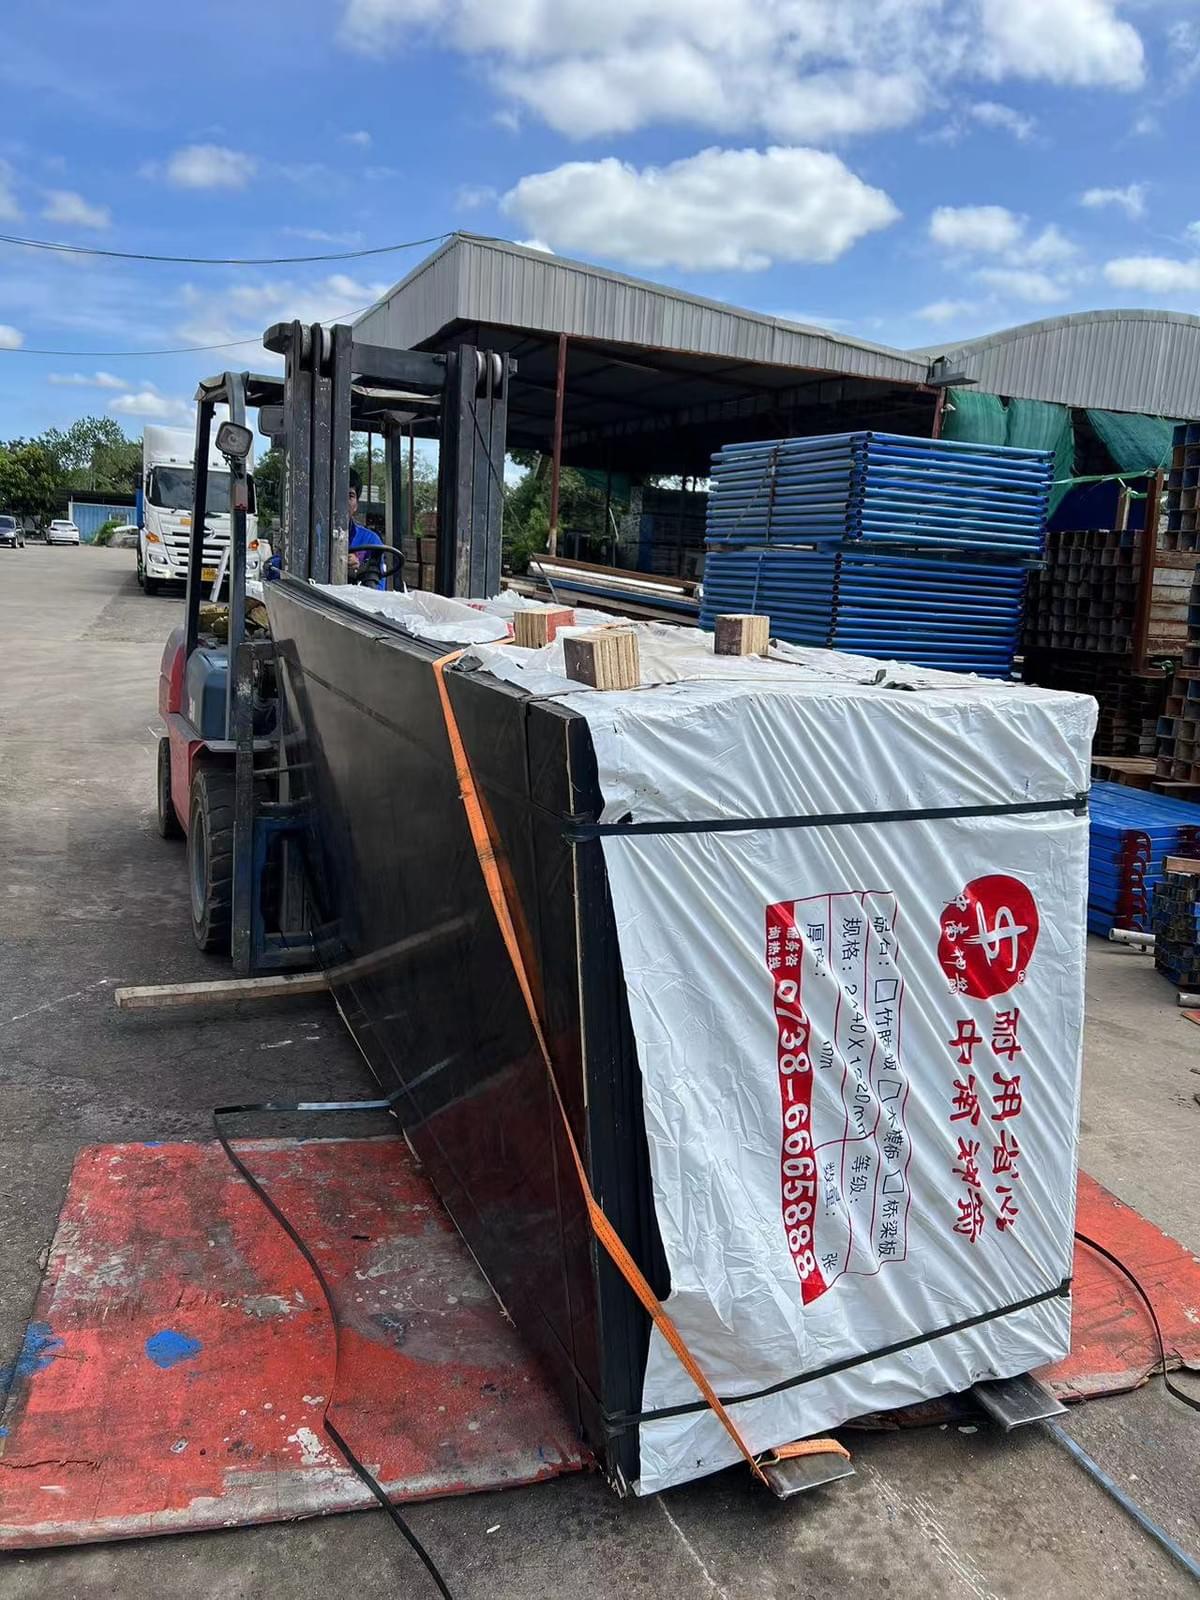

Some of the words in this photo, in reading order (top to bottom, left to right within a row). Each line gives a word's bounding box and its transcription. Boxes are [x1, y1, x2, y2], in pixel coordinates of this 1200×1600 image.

[774, 978, 816, 1280] 0738-6665888
[878, 1199, 900, 1258] 桥梁板
[948, 1018, 986, 1244] 中南神箭
[991, 1008, 1023, 1233] 耐用省心
